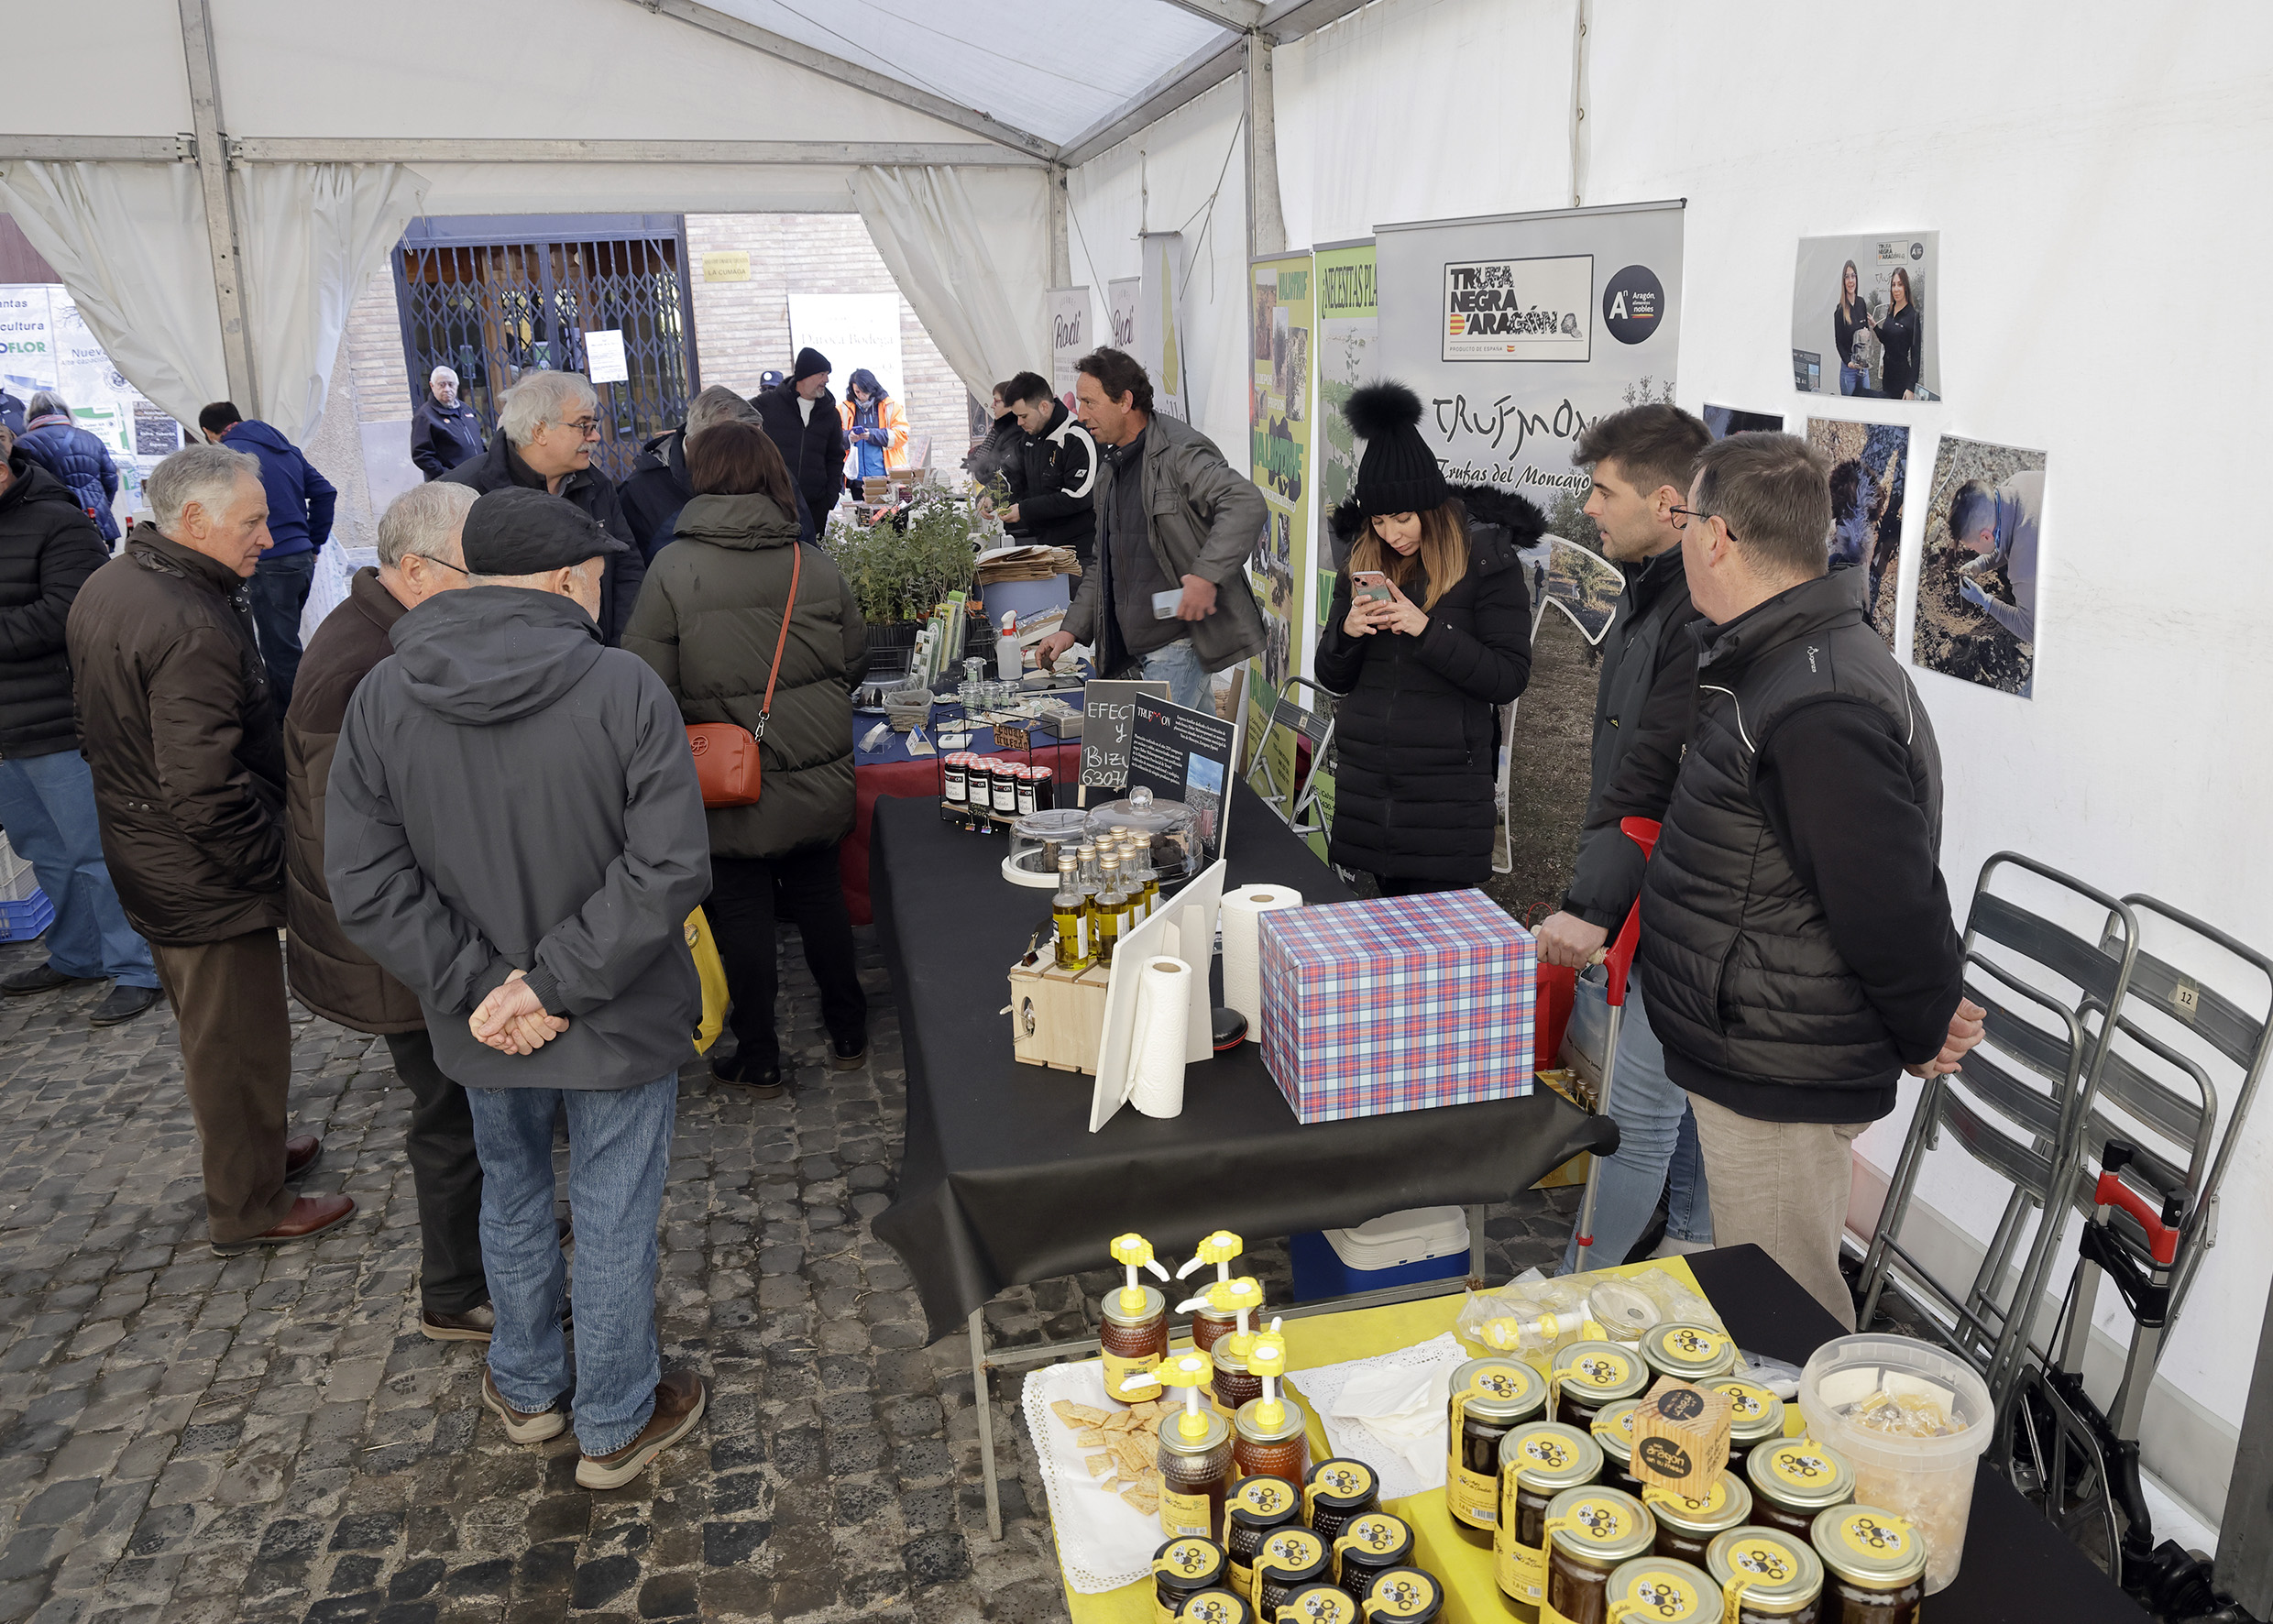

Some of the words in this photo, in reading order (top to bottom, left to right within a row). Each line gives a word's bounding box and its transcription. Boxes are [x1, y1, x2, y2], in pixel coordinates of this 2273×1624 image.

[1322, 265, 1363, 320] ¿NECESITAS
[1450, 266, 1516, 291] TRUFA
[1450, 289, 1519, 313] NEGRA
[1053, 310, 1082, 350] Rodi
[1492, 463, 1514, 484] del
[1515, 465, 1592, 497] Moncayo
[2180, 992, 2192, 1005] 12
